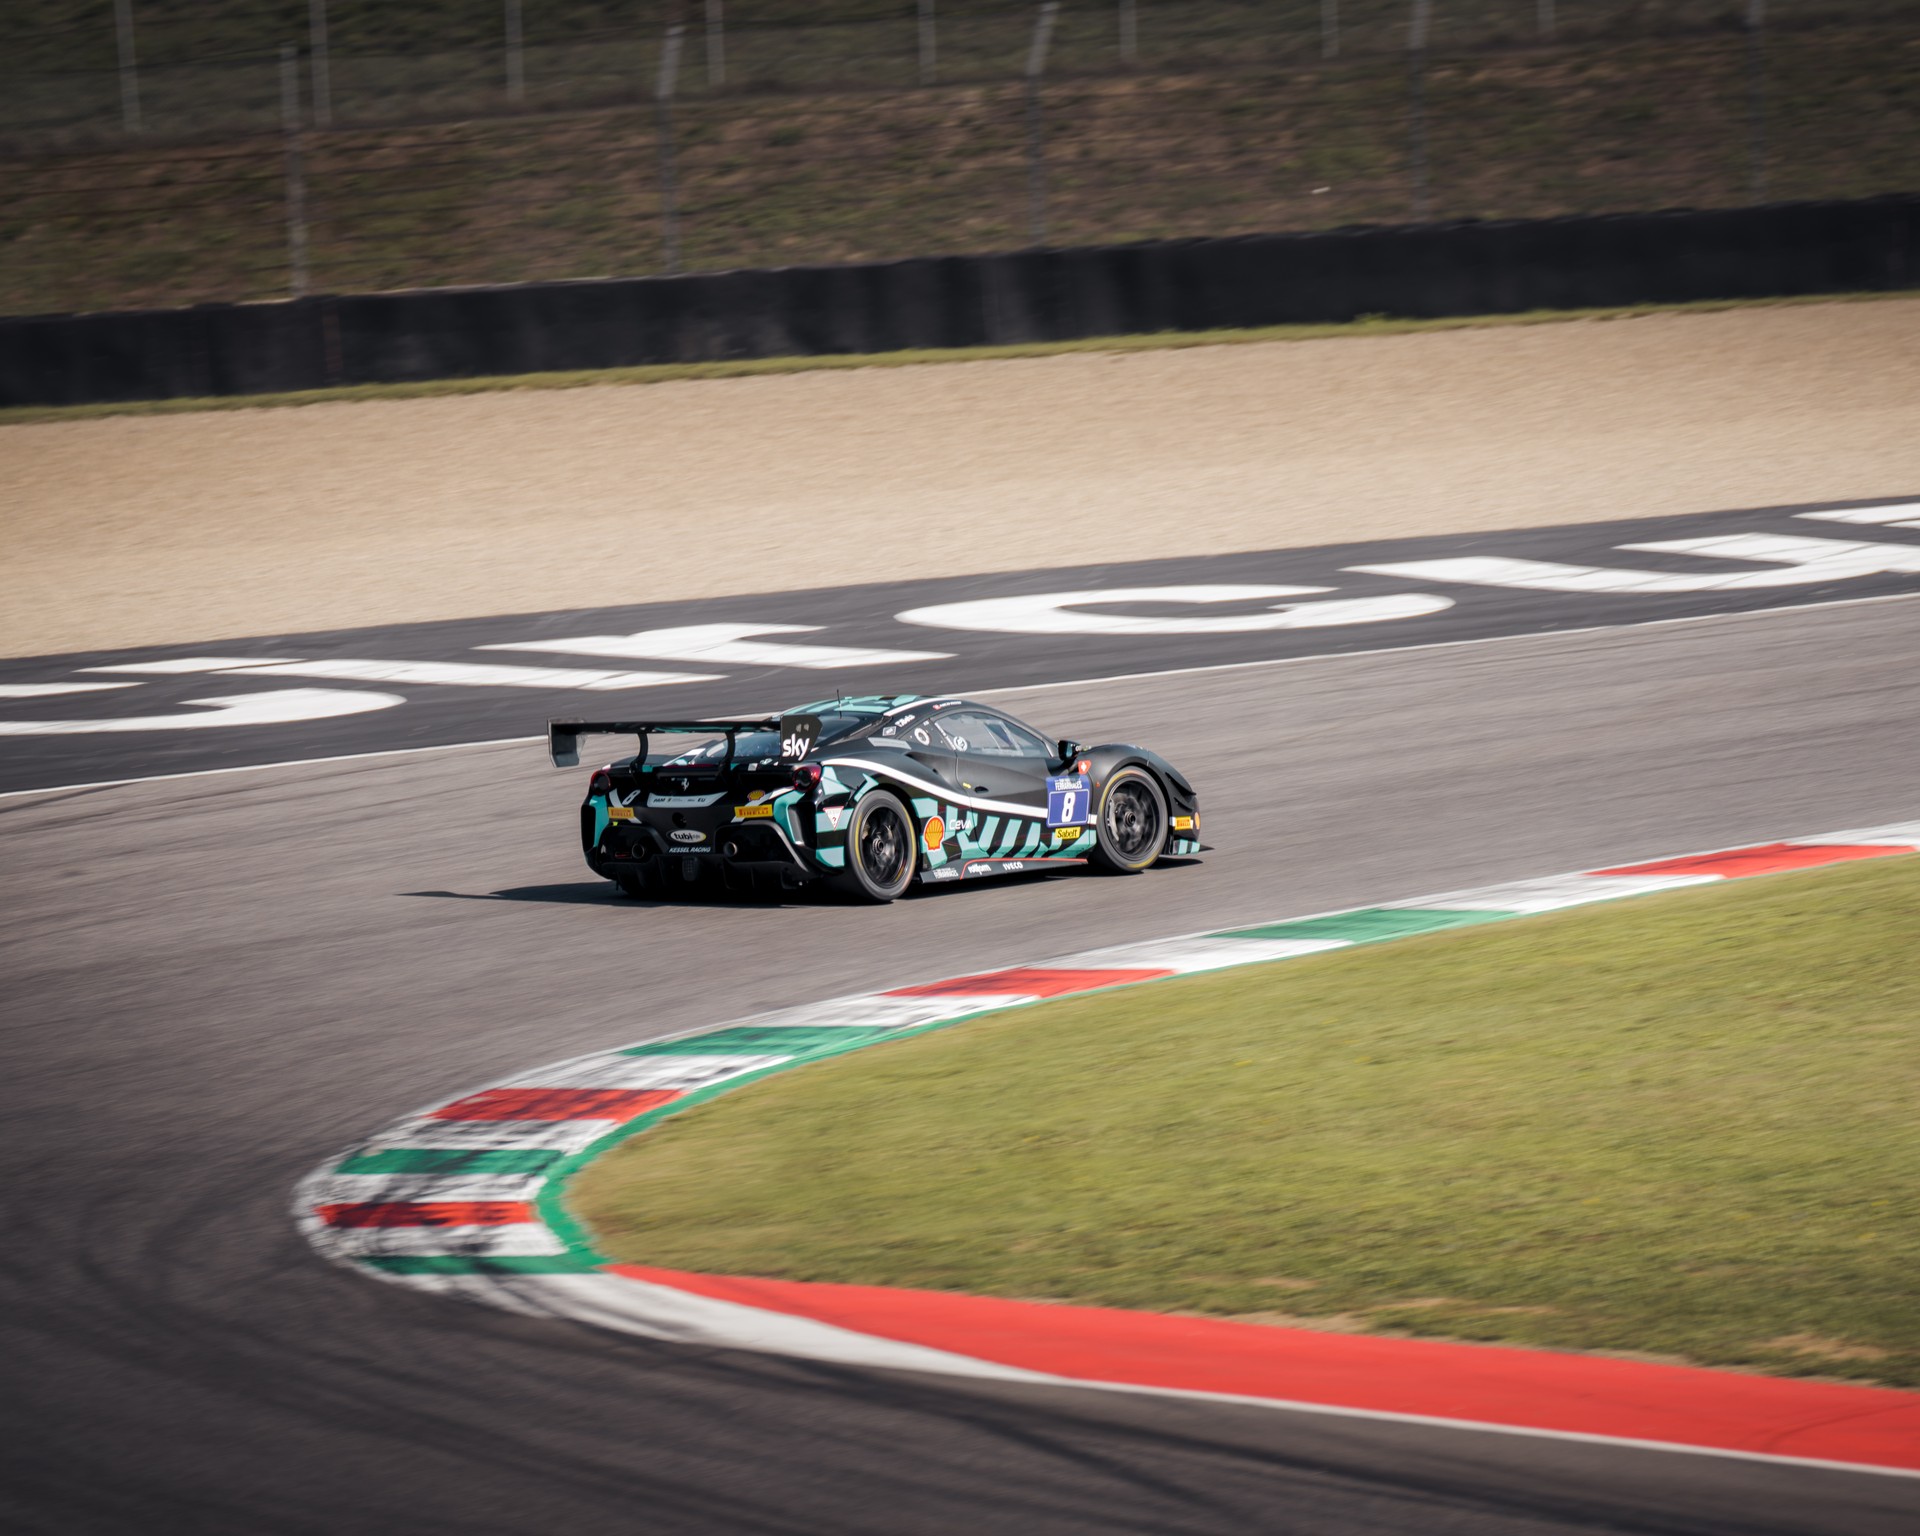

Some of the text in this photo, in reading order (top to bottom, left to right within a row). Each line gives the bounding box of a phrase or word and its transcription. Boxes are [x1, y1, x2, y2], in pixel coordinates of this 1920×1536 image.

[782, 733, 810, 761] sky
[738, 806, 769, 816] PIRELLI
[1062, 792, 1076, 823] 8
[673, 832, 692, 840] tubi
[1057, 829, 1078, 839] Sabelt
[1002, 861, 1024, 870] IVECO
